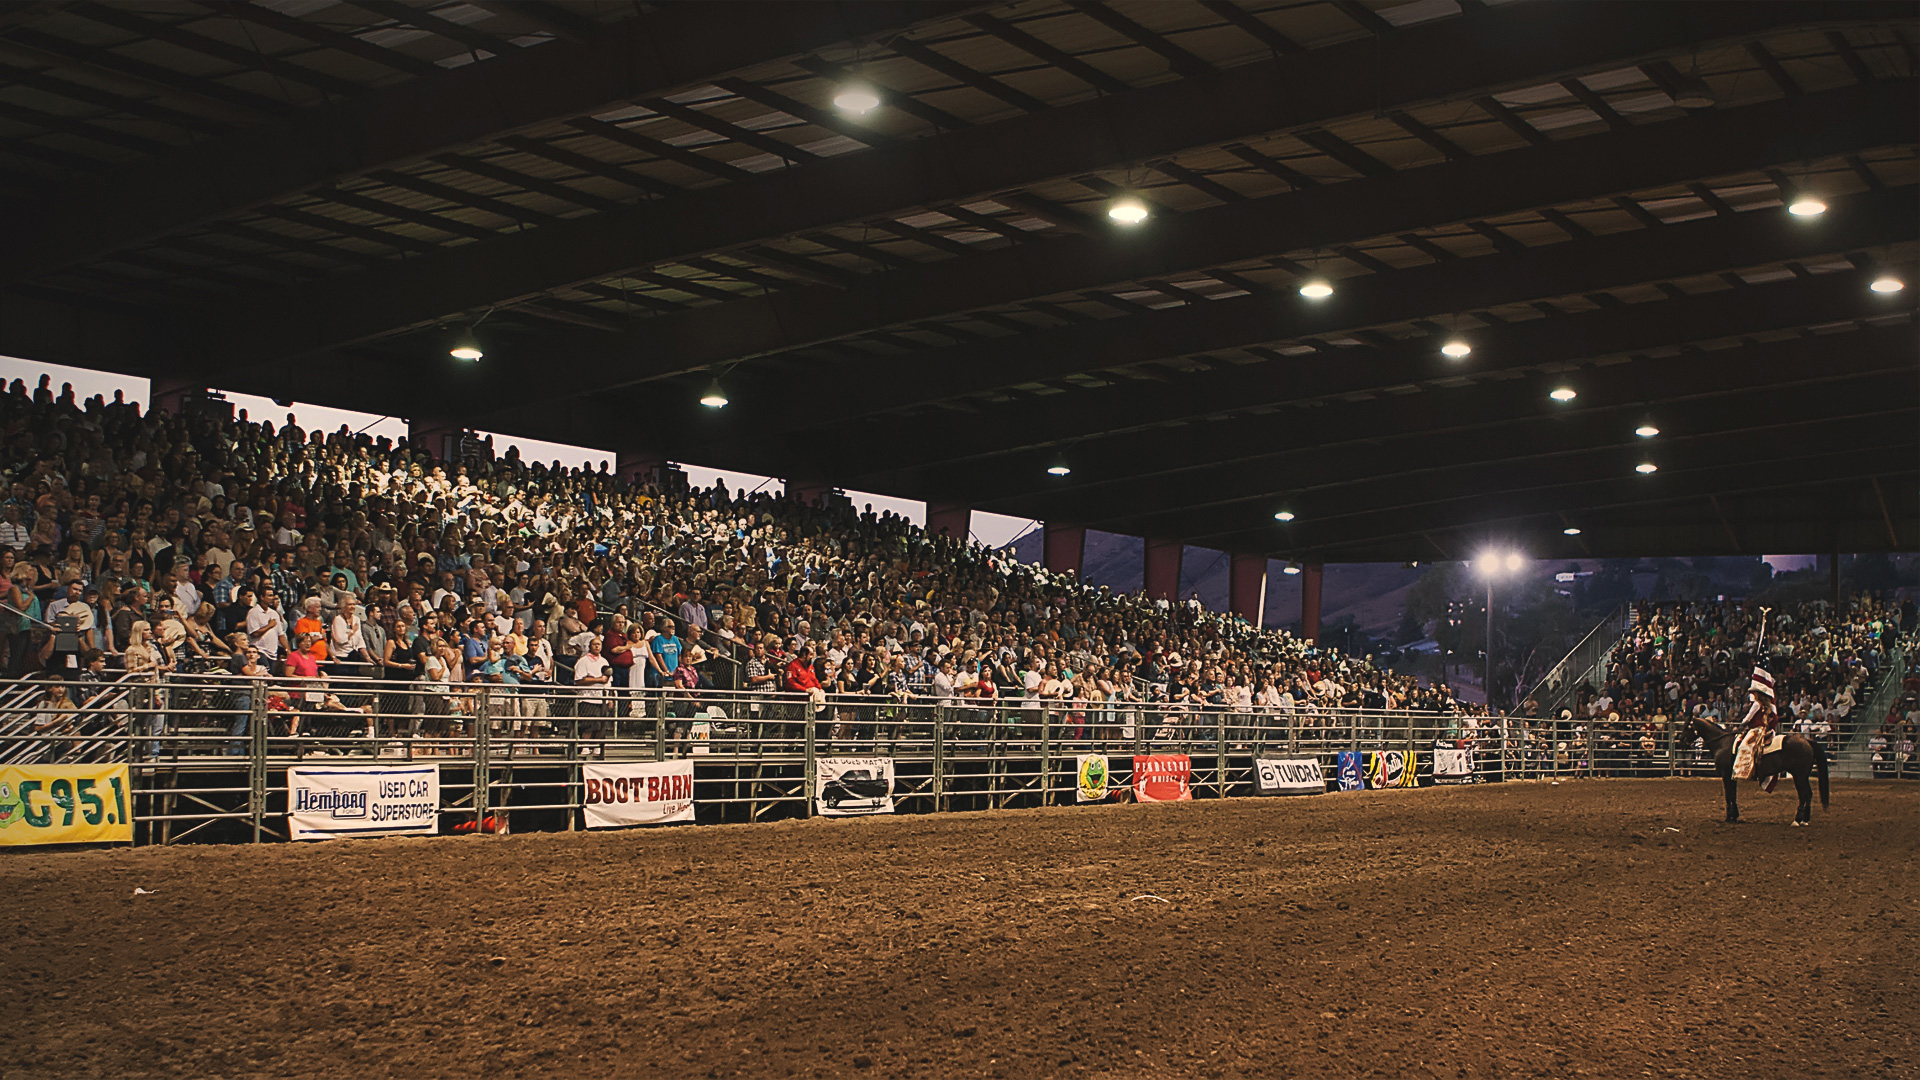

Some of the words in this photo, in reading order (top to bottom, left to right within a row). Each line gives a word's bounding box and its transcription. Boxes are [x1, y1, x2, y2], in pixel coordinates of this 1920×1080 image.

[1274, 763, 1322, 783] TUNDRA
[379, 780, 406, 799] USED
[408, 779, 428, 798] CAR
[585, 777, 644, 805] BOOT
[647, 773, 692, 802] BARN
[371, 802, 434, 821] SUPERSTORE
